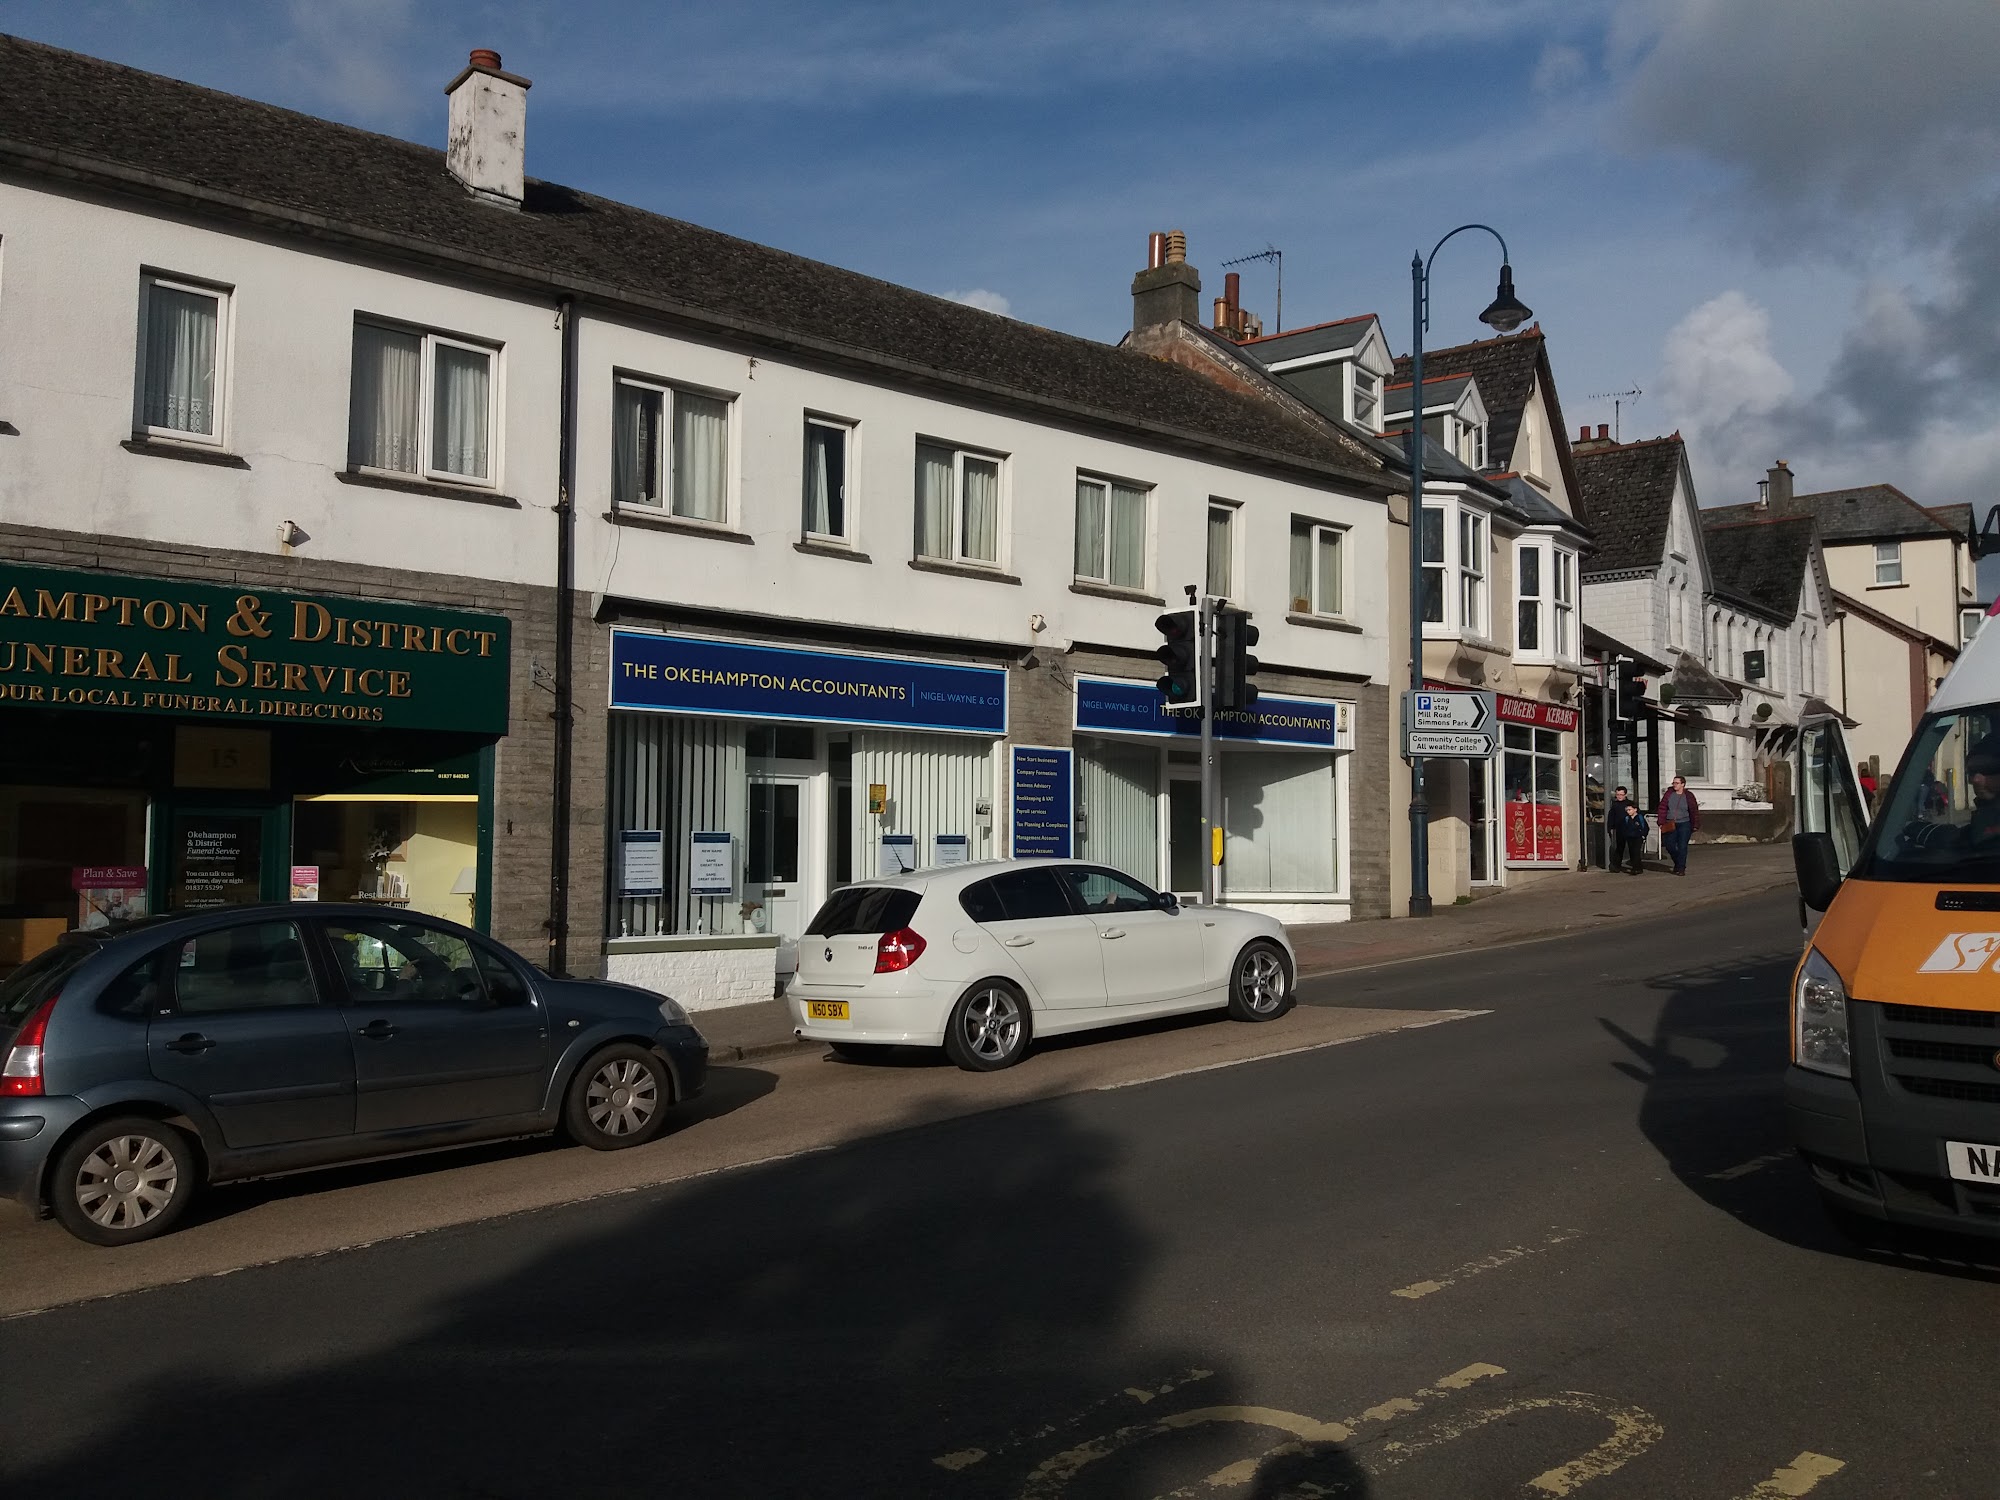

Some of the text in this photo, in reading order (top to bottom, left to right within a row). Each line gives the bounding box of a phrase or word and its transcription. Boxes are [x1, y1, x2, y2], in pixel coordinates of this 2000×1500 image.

[0, 586, 497, 657] AMPTON & DISTRICT
[216, 645, 411, 698] SERVICE
[622, 662, 1000, 706] THE OKEHAMPTON ACCOUNTANTS NIGEL WAYNE & CO
[51, 686, 137, 707] LOCAL
[142, 692, 254, 714] FUNERAL
[259, 699, 384, 722] DIRECTORS
[1082, 700, 1103, 710] NIGEL
[1104, 702, 1129, 712] WAYNE
[1137, 705, 1149, 713] CO
[1160, 705, 1180, 717] THE
[1258, 714, 1331, 730] ACCOUNTANTS
[1502, 699, 1574, 726] BURGERS KEBABS
[1412, 735, 1482, 744] Community College
[1460, 744, 1477, 752] pitch
[1016, 768, 1035, 776] Company
[187, 831, 237, 840] Okehampton
[83, 868, 138, 878] Plan & Save
[358, 891, 376, 899] Rest
[812, 1003, 844, 1017] N50 SBX
